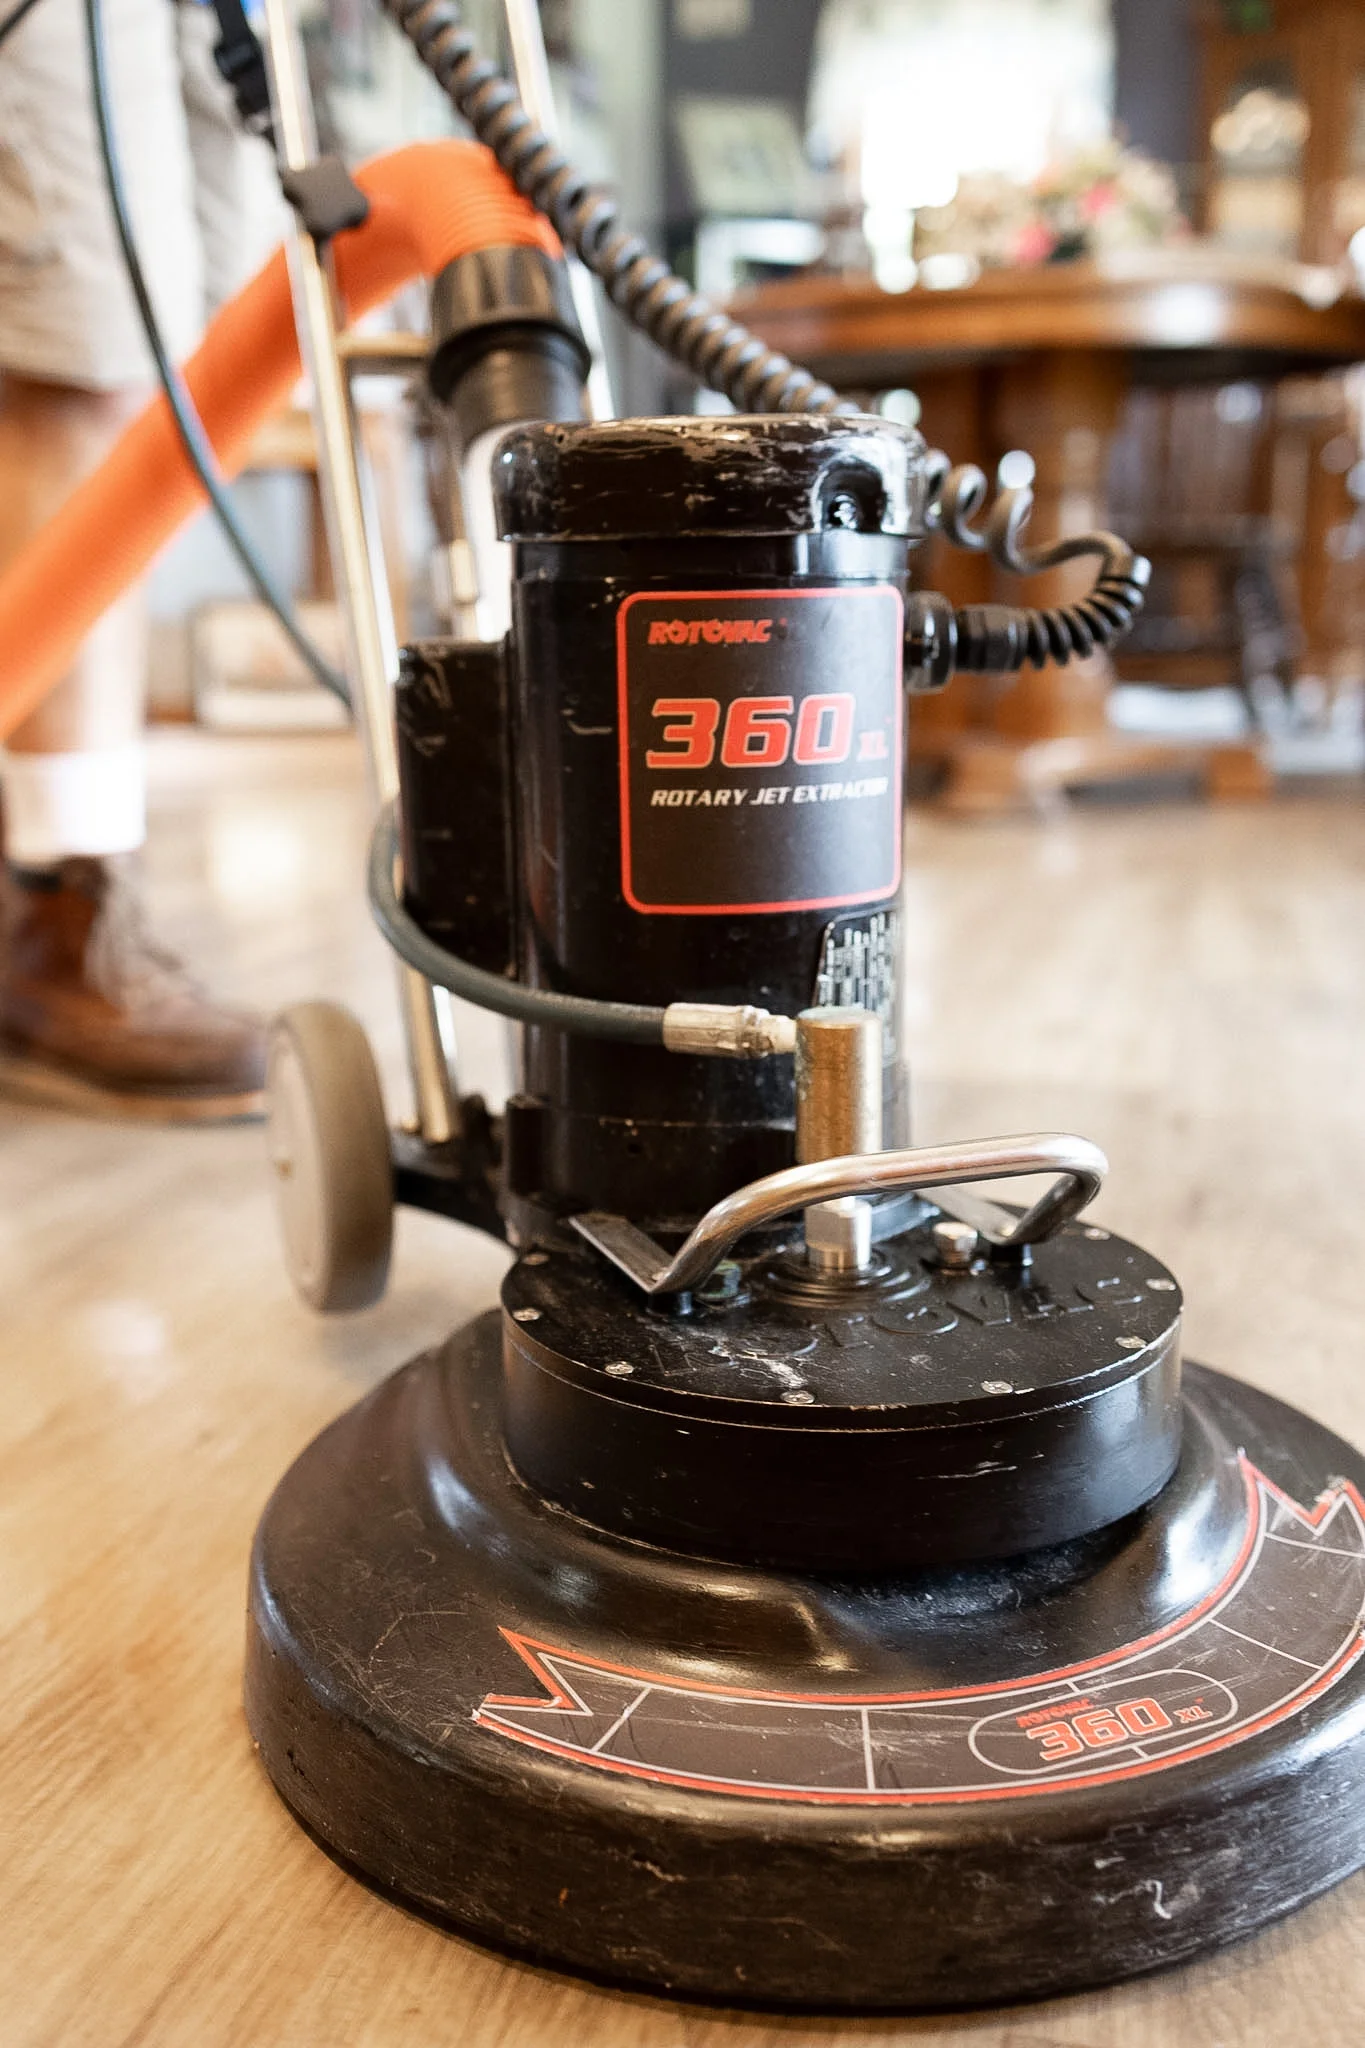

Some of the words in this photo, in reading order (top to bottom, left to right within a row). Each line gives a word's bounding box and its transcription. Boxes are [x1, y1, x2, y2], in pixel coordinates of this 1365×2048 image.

[645, 692, 856, 769] 360
[651, 789, 749, 807] ROTARY
[751, 786, 793, 806] JET
[1025, 1697, 1174, 1761] 360
[1173, 1705, 1213, 1724] XL
